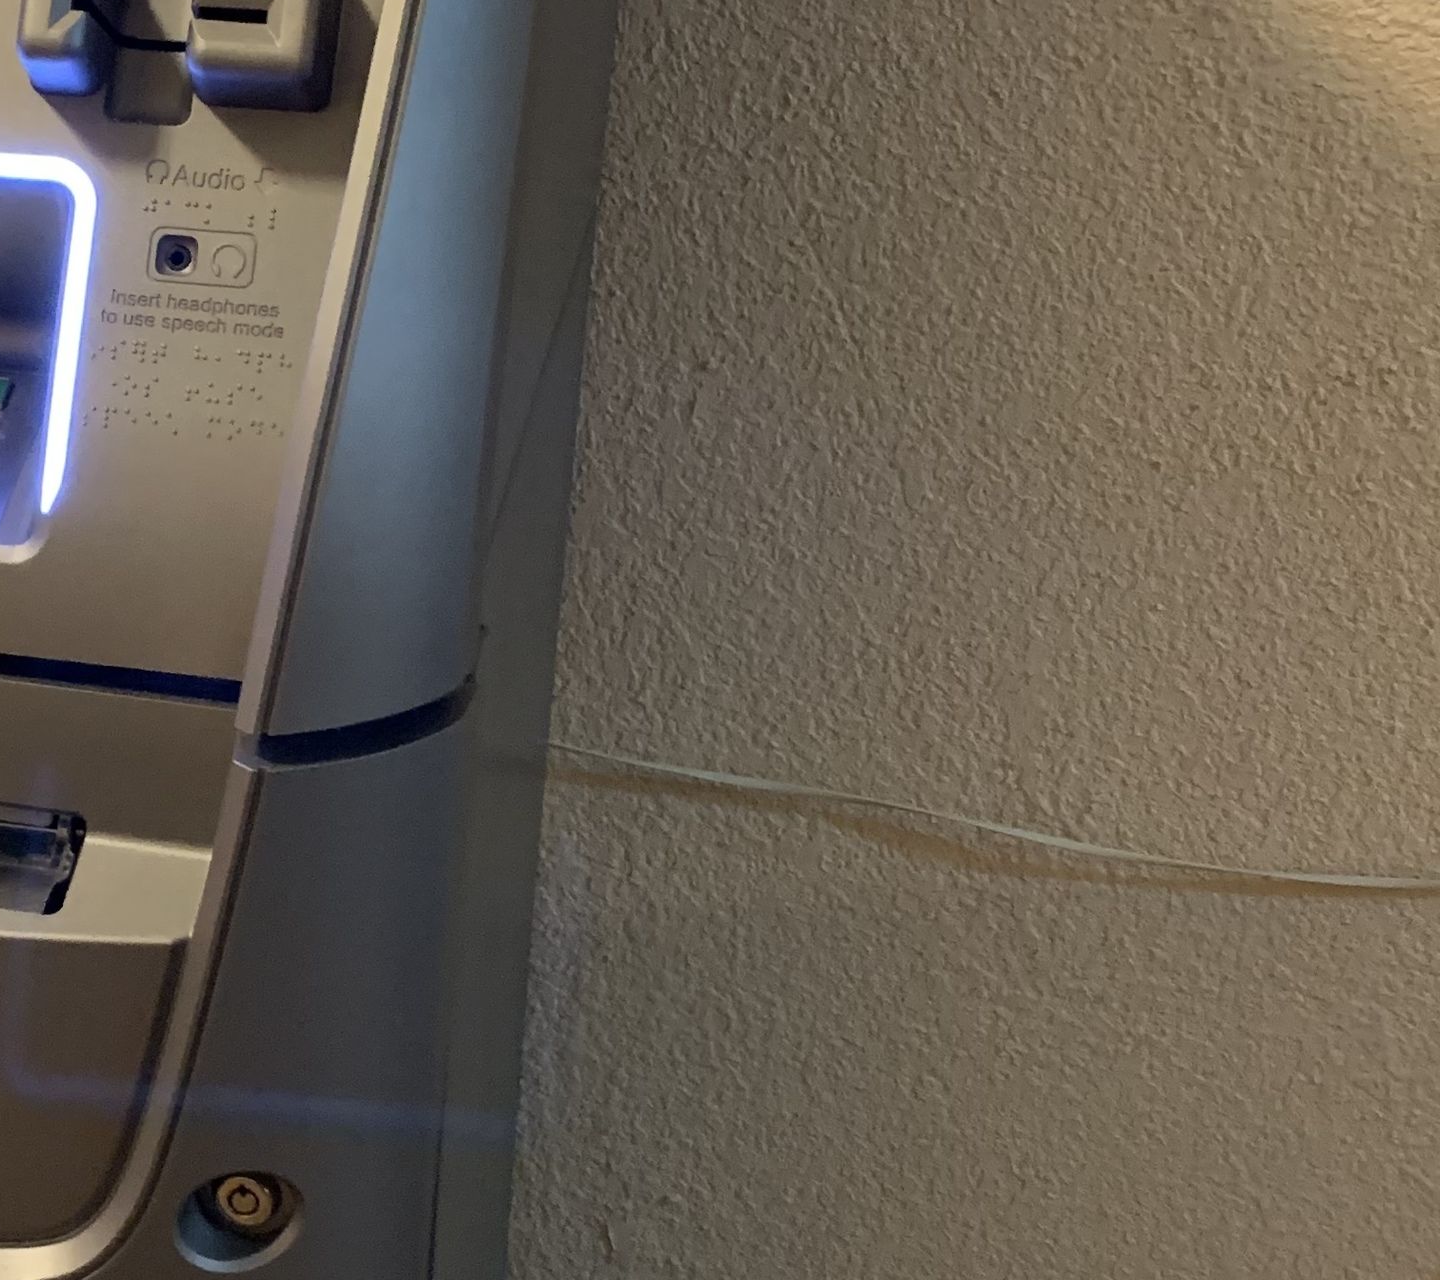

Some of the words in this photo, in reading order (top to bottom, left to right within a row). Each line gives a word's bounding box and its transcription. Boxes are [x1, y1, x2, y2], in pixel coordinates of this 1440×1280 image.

[171, 164, 246, 192] Audio
[166, 293, 281, 318] headphones
[100, 308, 118, 325] to
[123, 313, 156, 329] use
[161, 315, 227, 336] speech
[232, 320, 285, 340] mode
